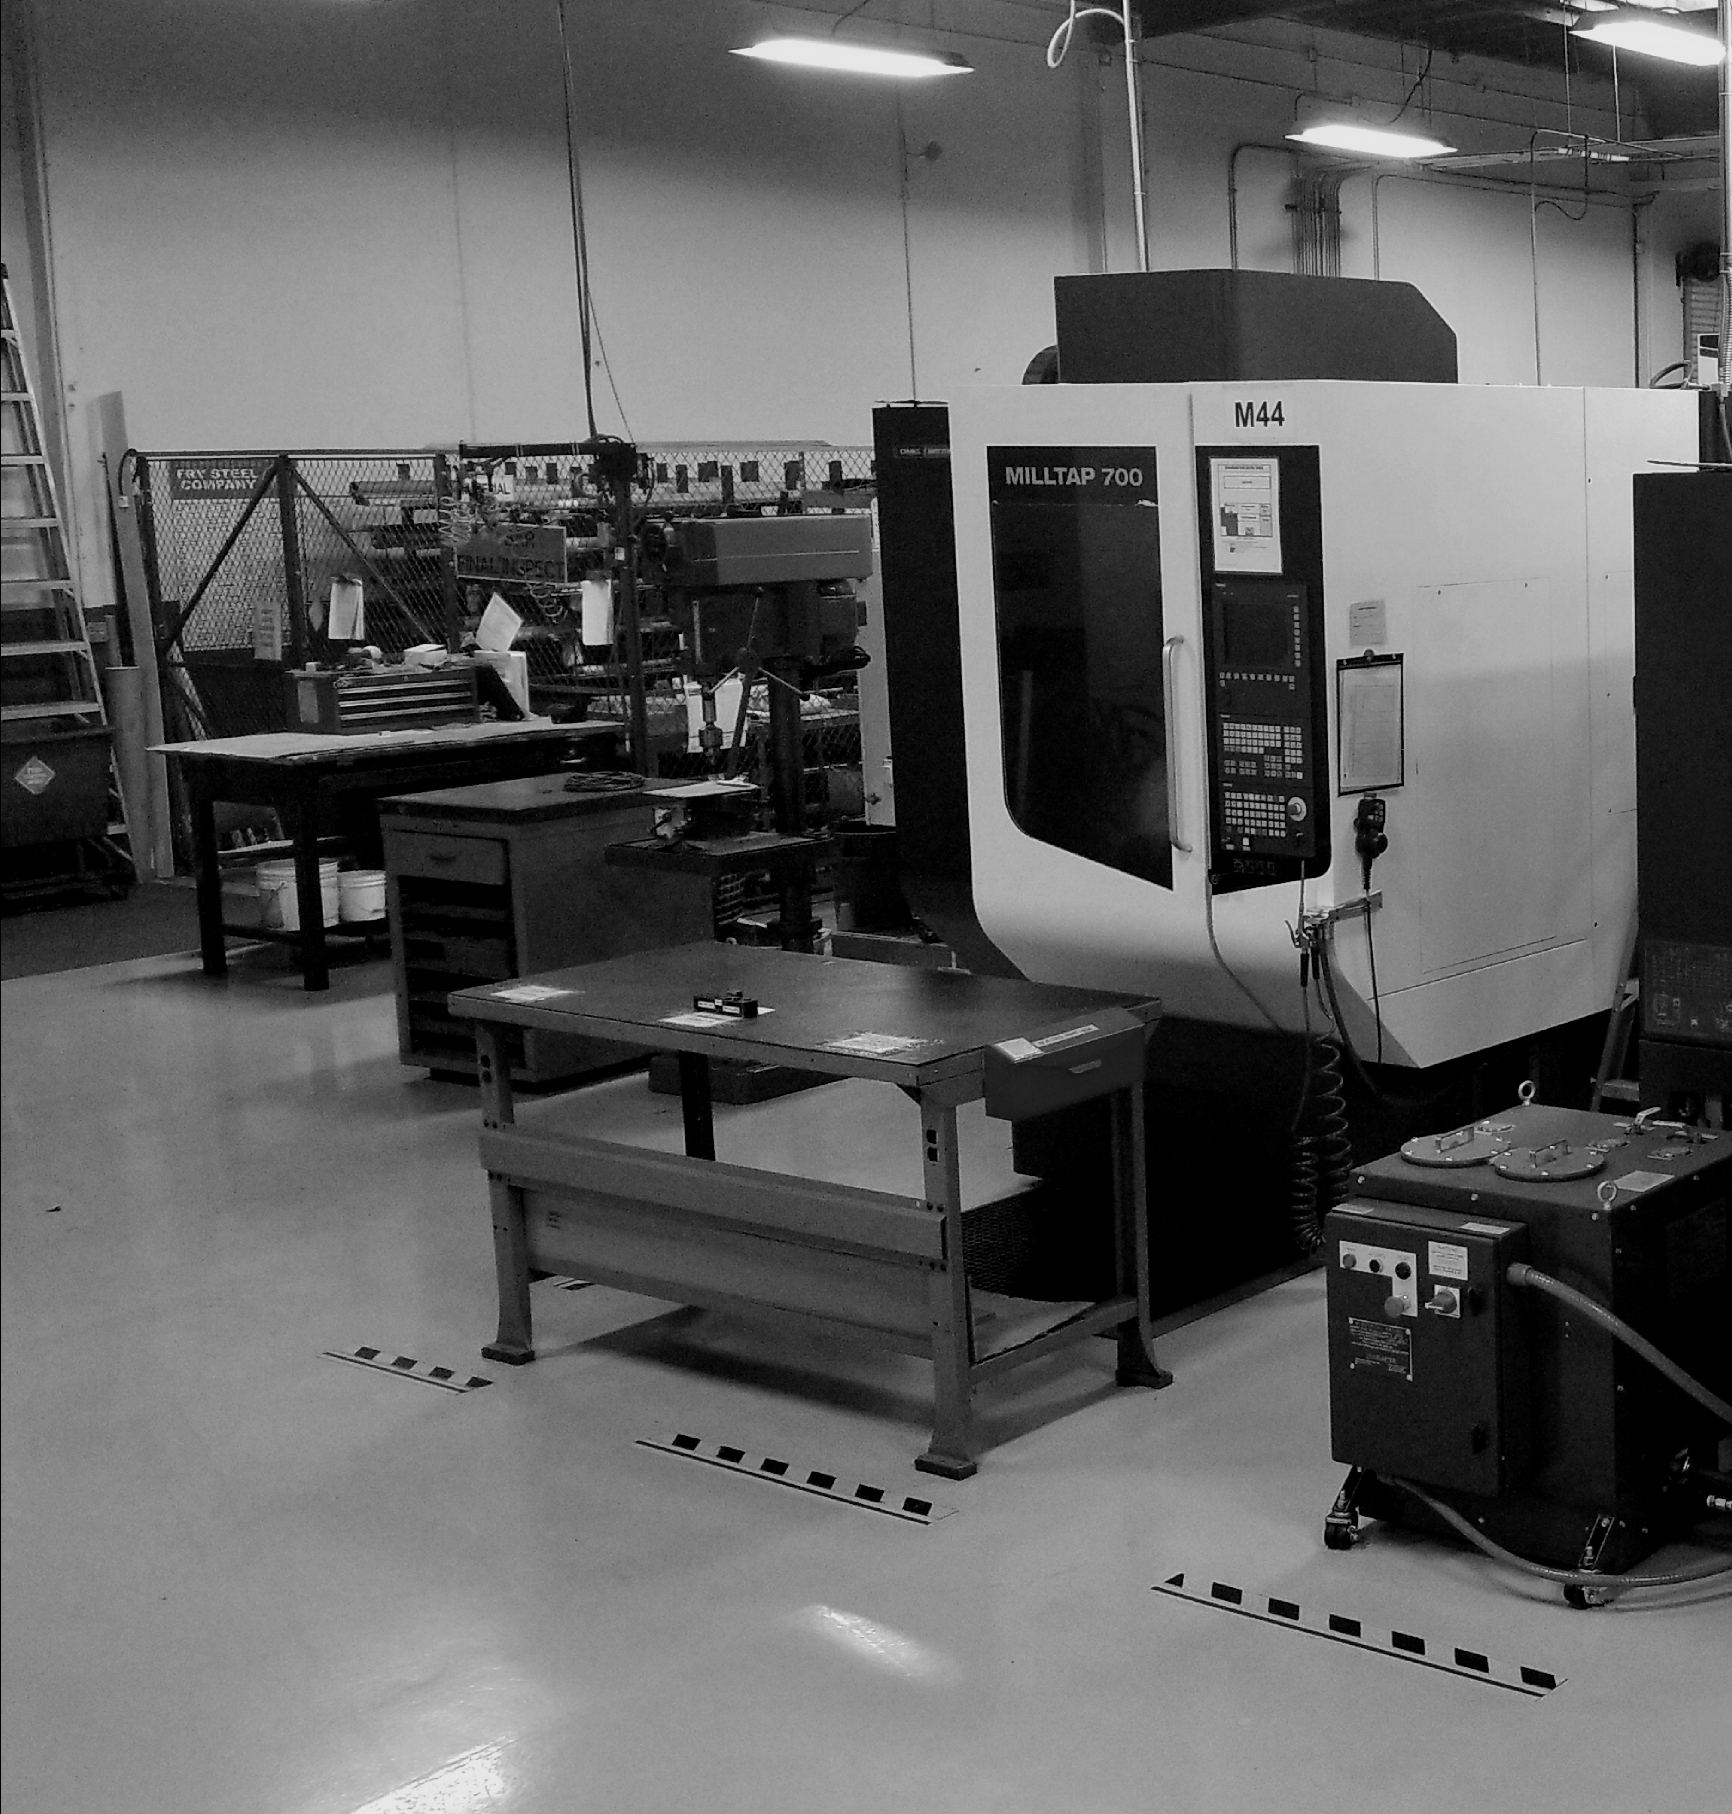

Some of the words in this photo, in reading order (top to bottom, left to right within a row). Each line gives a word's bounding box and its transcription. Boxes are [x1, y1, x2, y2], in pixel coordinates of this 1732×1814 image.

[1235, 401, 1285, 427] M44
[211, 468, 259, 480] STEEL
[1005, 466, 1096, 486] MILLTAP
[1102, 467, 1143, 486] 700
[180, 478, 257, 490] COMPANY
